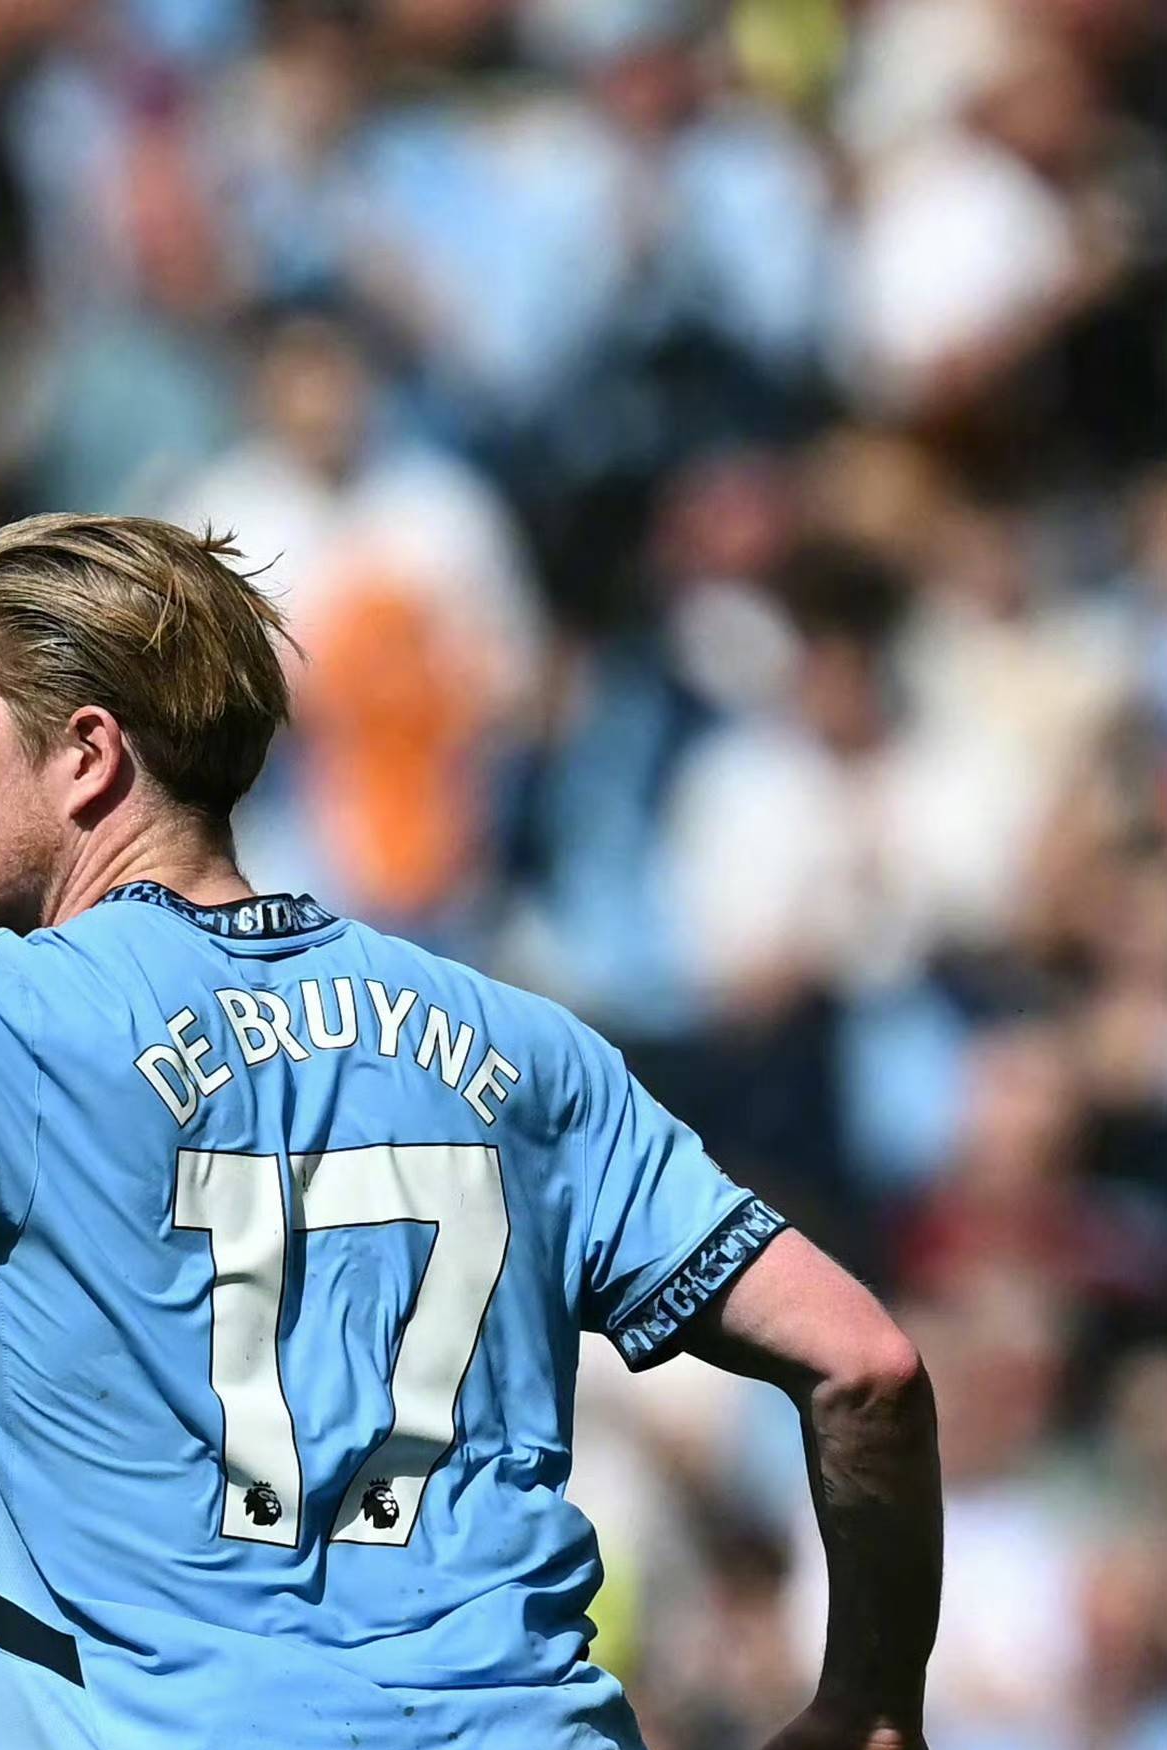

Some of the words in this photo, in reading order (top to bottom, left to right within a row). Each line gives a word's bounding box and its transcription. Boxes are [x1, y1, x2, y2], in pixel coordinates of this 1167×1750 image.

[133, 1006, 234, 1128] DE
[214, 976, 521, 1126] BRUYNE
[172, 1143, 510, 1549] 17
